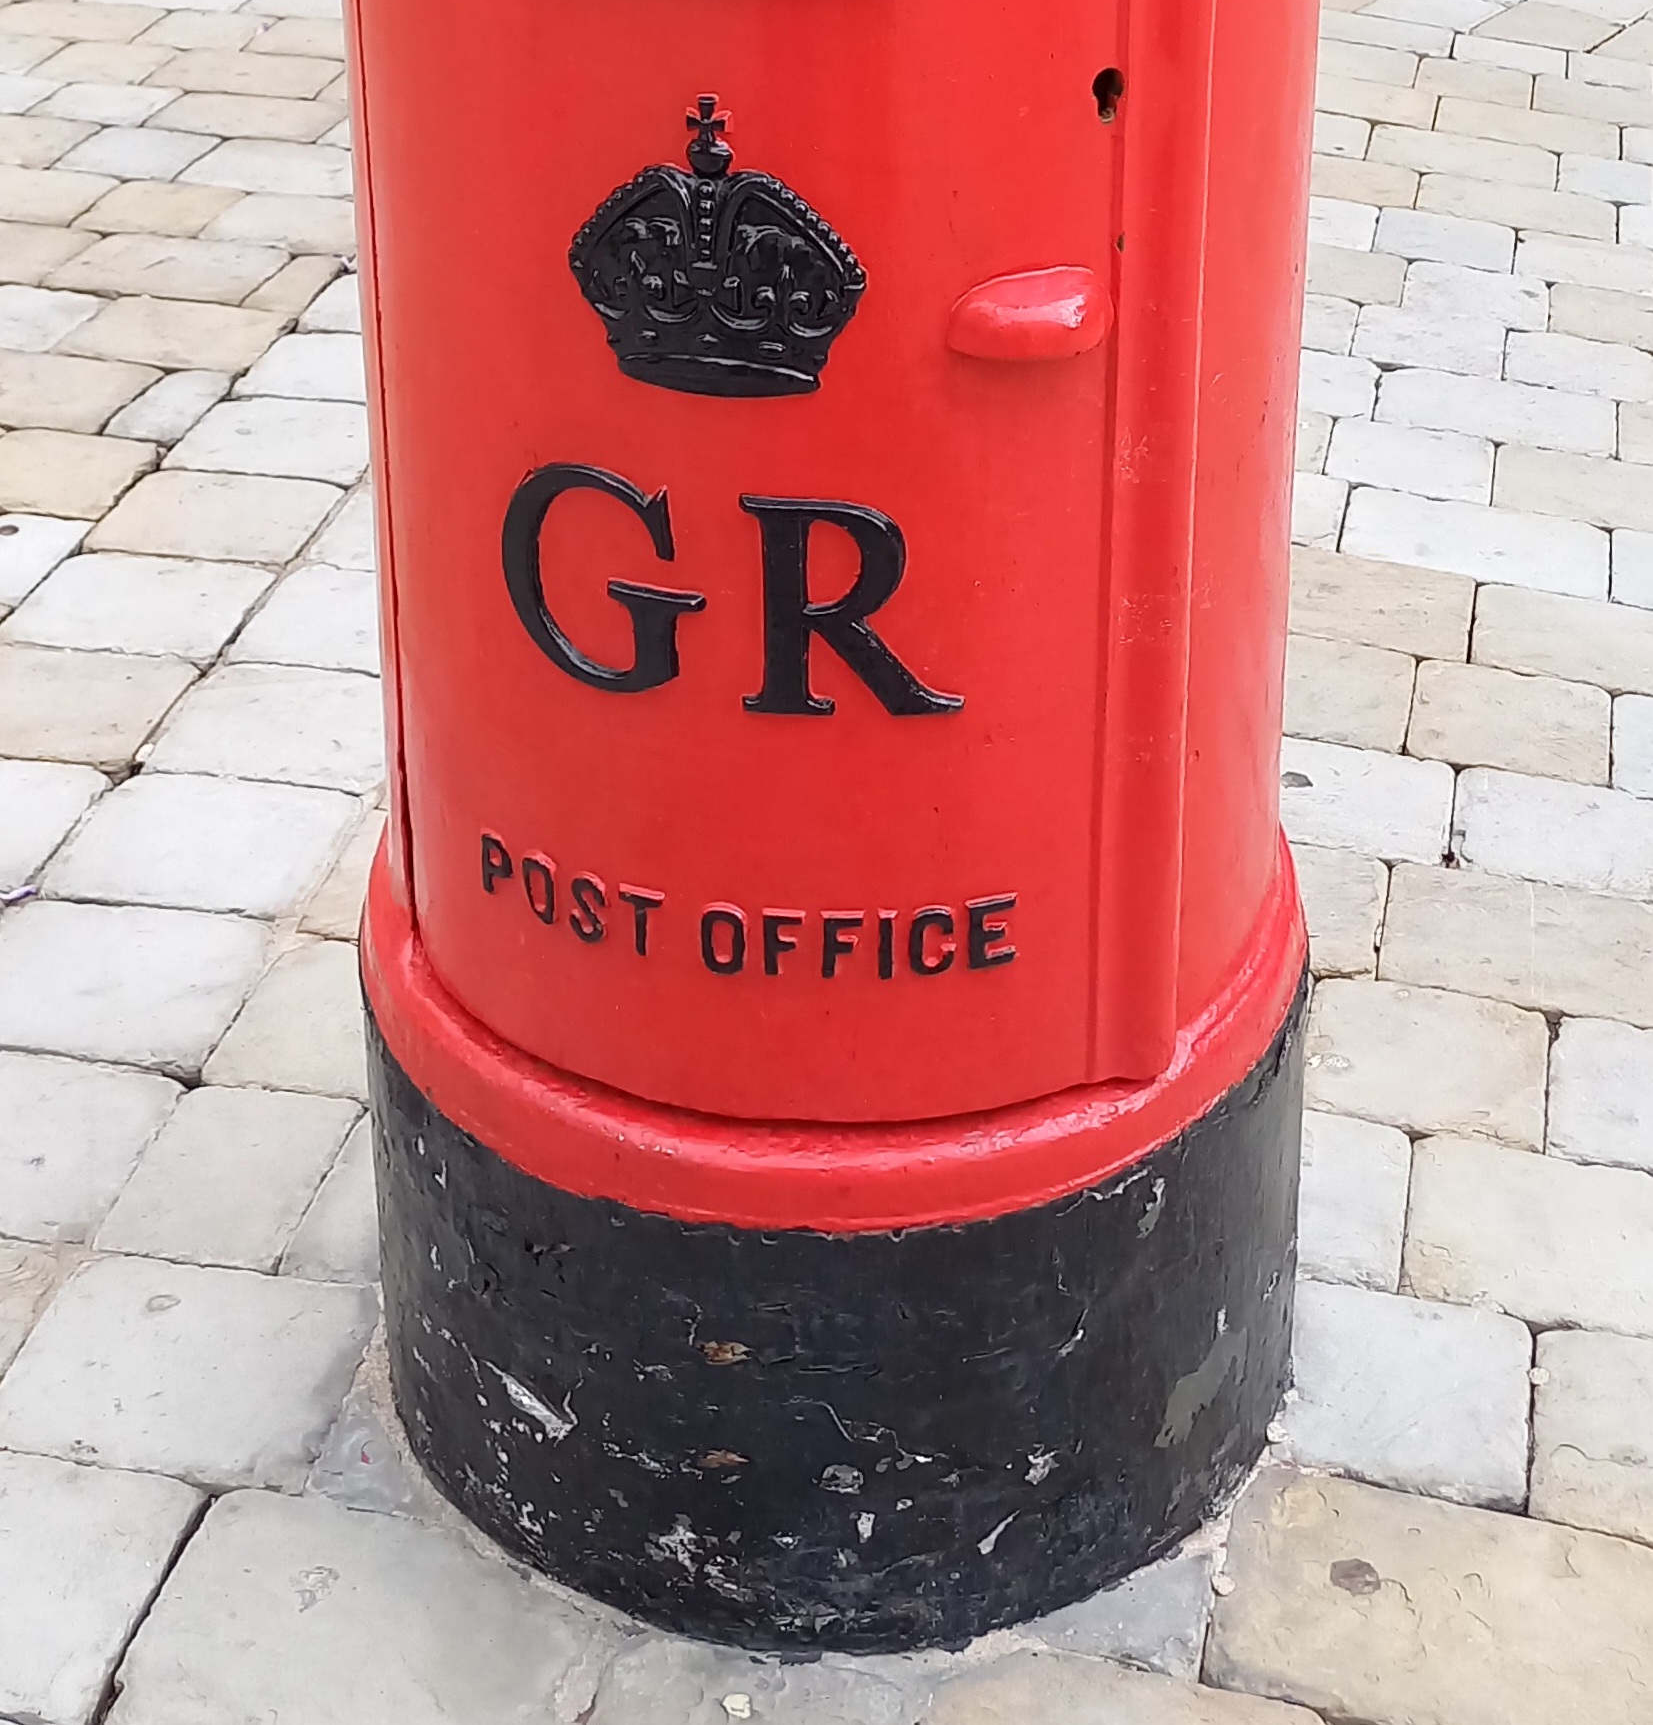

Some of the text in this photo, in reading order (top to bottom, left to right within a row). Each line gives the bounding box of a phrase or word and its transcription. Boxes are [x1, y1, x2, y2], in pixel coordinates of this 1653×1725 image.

[502, 462, 965, 716] GR
[480, 827, 1019, 981] POST OFFICE
